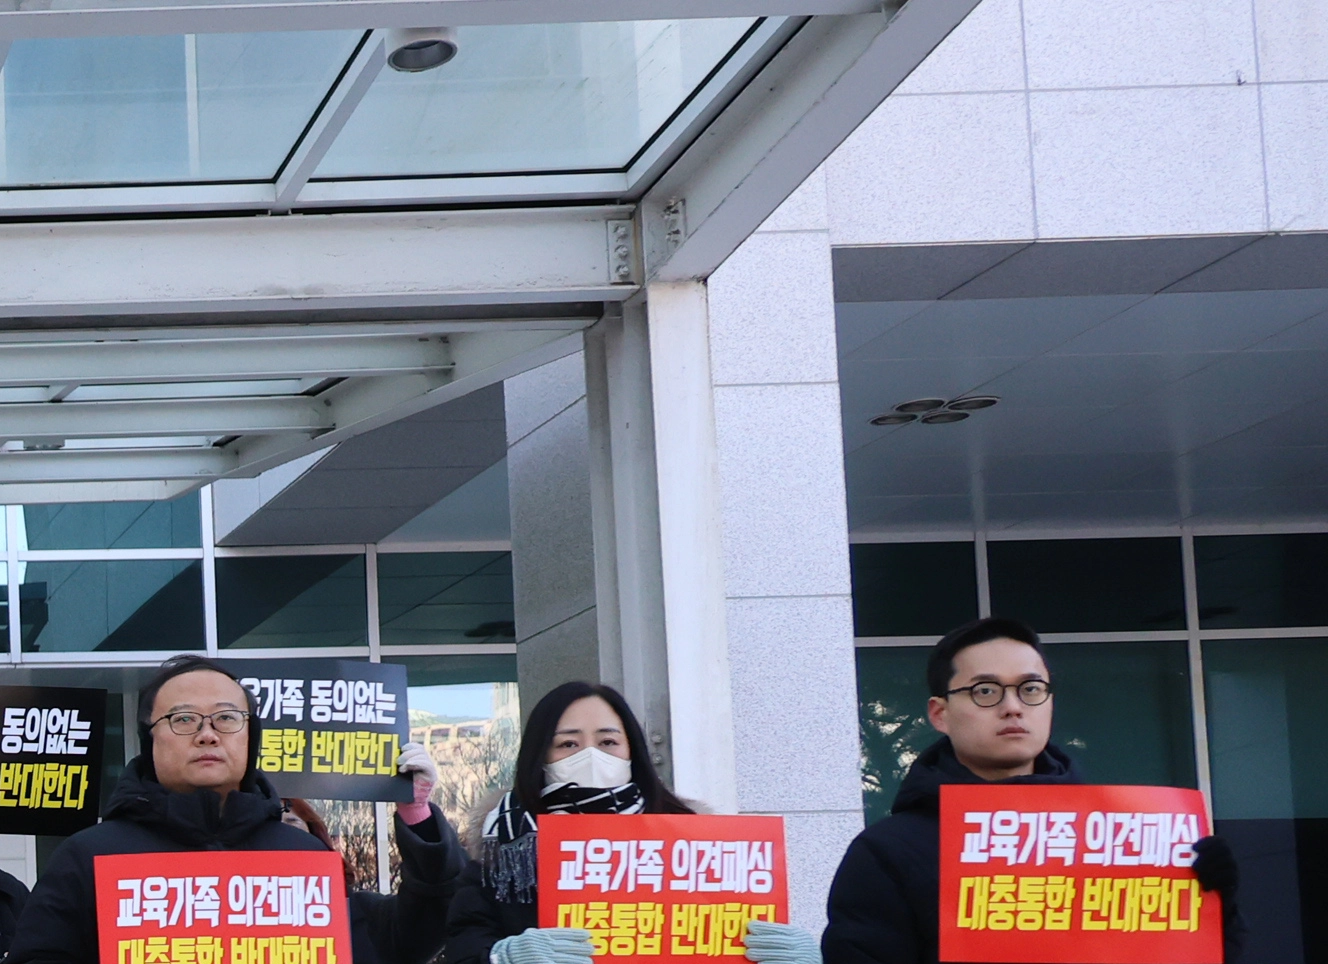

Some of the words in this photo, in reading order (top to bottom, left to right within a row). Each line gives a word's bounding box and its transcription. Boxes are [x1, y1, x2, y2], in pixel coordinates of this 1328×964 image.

[236, 678, 304, 722] 가족
[311, 680, 396, 724] 동의없는
[2, 708, 90, 754] 동의없는
[258, 729, 305, 771] 통합
[312, 732, 400, 775] 반대한다
[961, 811, 1076, 866] 교육가족
[1084, 812, 1198, 866] 의견패싱
[558, 839, 664, 892] 교육가족
[670, 840, 772, 893] 의견패싱
[117, 877, 220, 928] 교육가족
[228, 876, 330, 926] 의견패싱
[958, 875, 1075, 930] 대충통합
[1082, 877, 1201, 932] 반대한다
